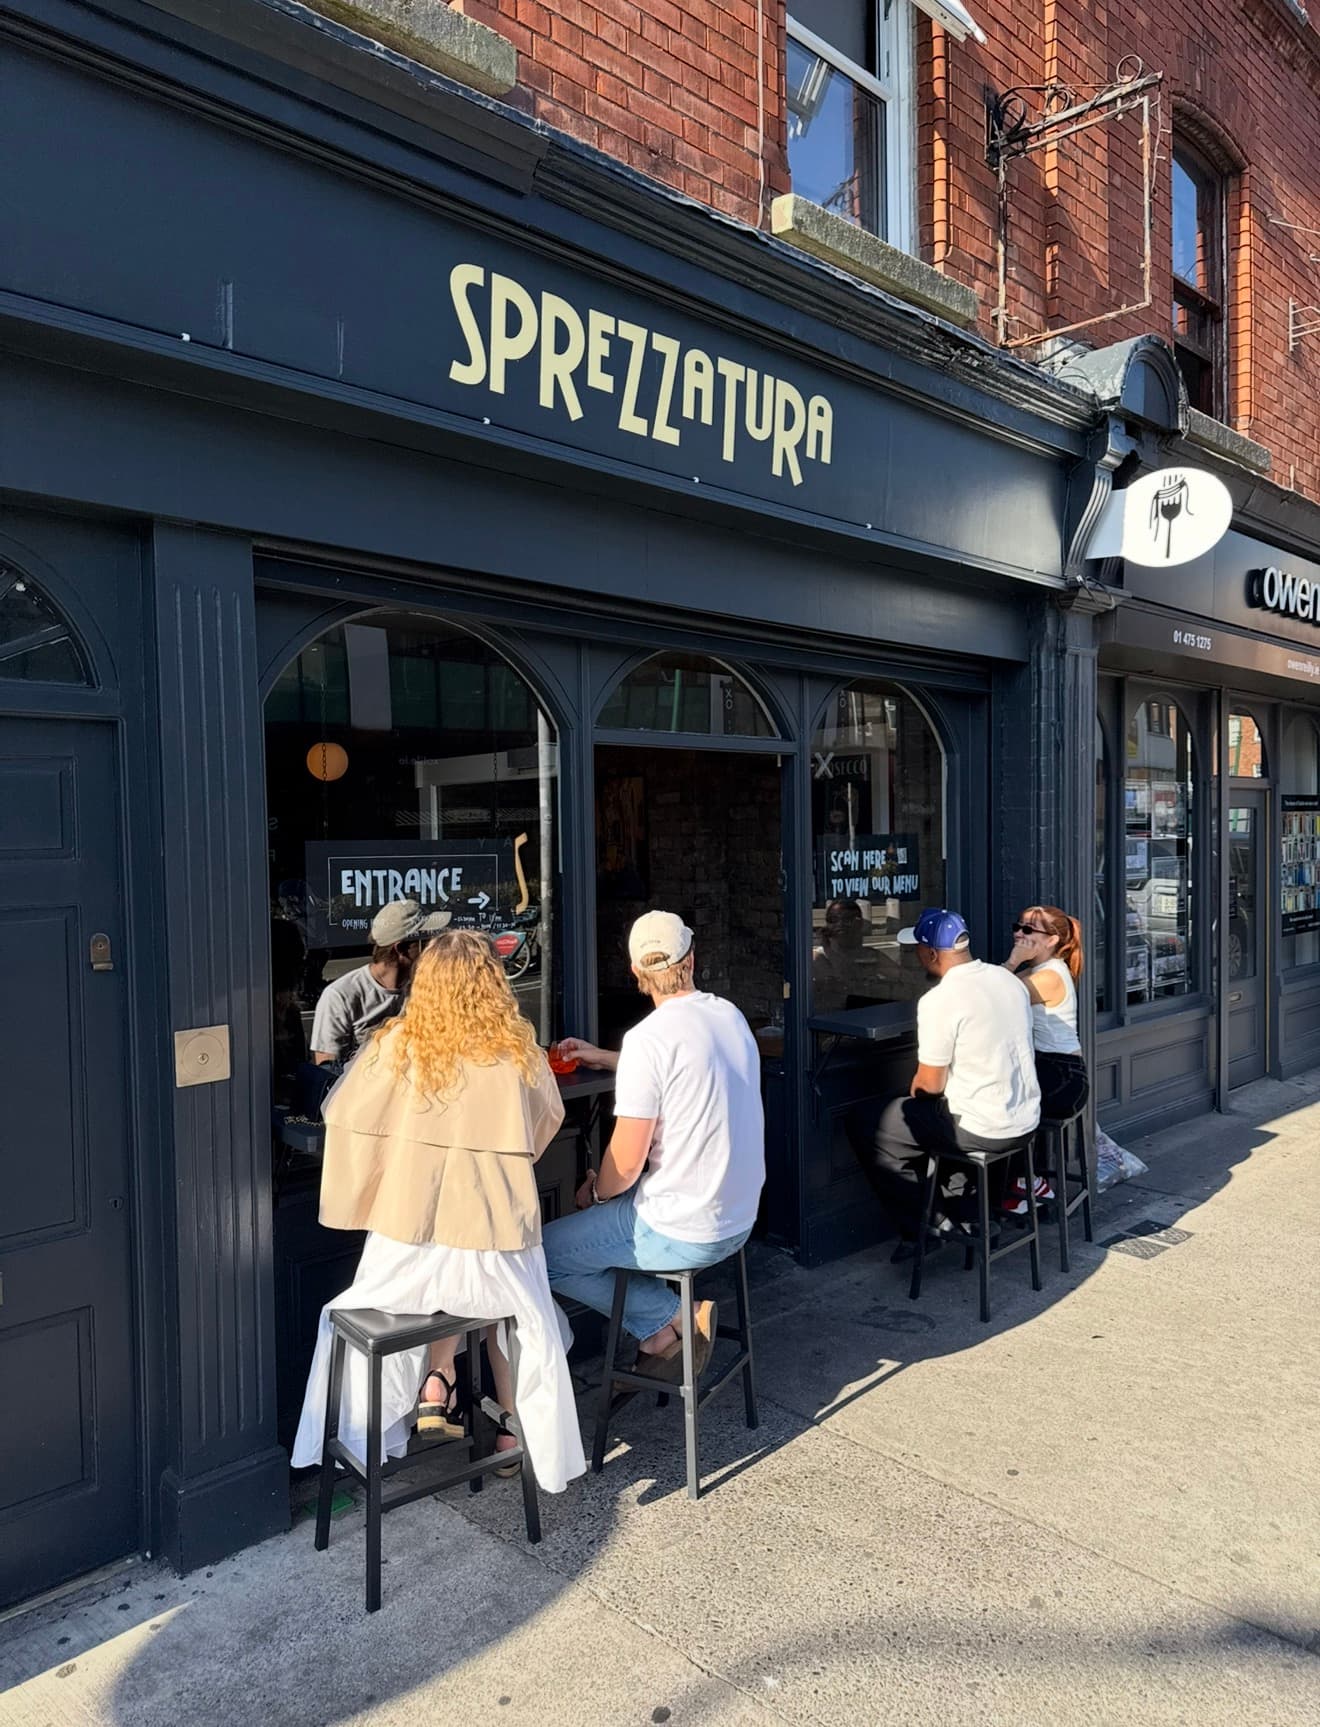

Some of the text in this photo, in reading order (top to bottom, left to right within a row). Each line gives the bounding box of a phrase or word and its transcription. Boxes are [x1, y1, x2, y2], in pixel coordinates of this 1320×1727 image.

[449, 263, 833, 487] SPREZZATURA
[1173, 629, 1212, 651] 01 475 1275
[831, 849, 886, 871] SCAN HERE
[341, 867, 463, 907] ENTRANCE
[831, 873, 918, 898] TO VIEW OUR MENU
[342, 918, 369, 931] OPENING
